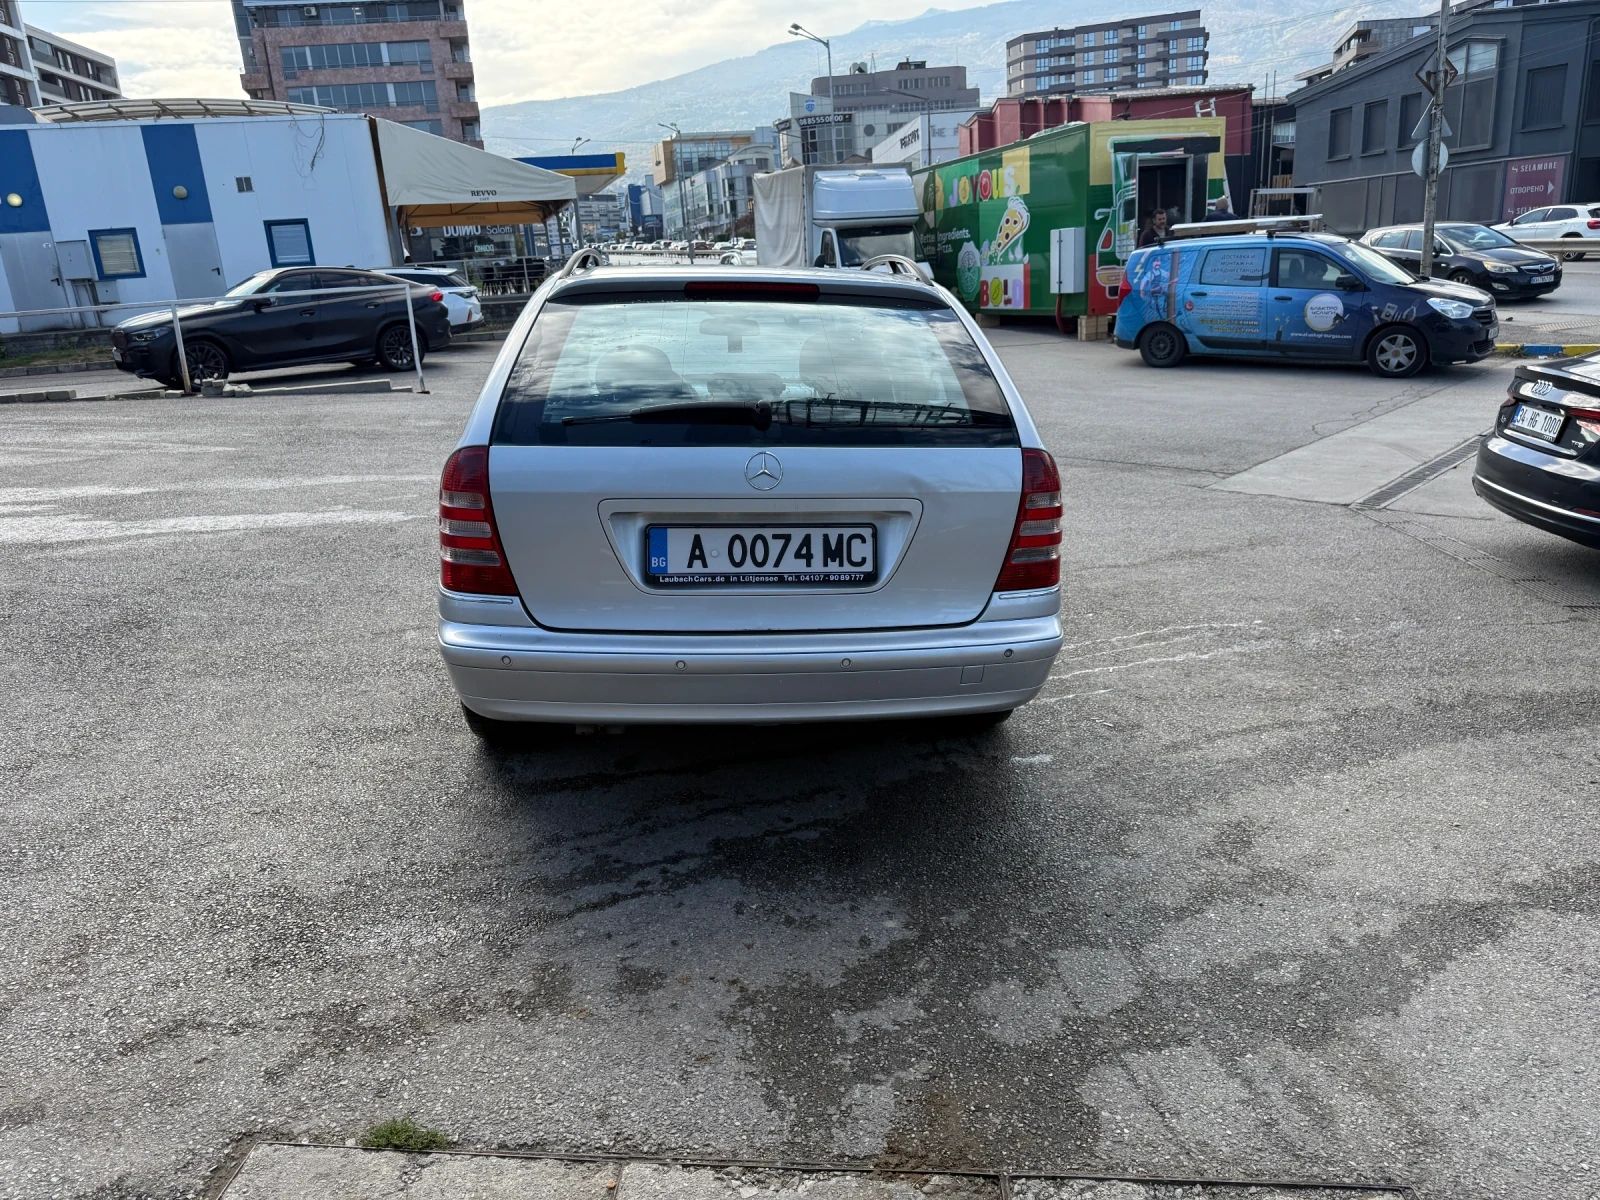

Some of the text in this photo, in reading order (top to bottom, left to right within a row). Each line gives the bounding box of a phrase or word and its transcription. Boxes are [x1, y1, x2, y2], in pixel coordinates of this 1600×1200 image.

[1520, 161, 1557, 172] SELAMORE
[470, 189, 497, 197] REVVO
[1510, 184, 1544, 194] ОТВОРЕНО
[486, 225, 513, 235] Salotti
[1517, 408, 1527, 425] 34
[1527, 411, 1540, 428] HG
[1540, 415, 1562, 435] 1000
[686, 533, 867, 568] A 0074 MC
[651, 557, 666, 567] BG
[659, 575, 725, 583] LaubachCars.de
